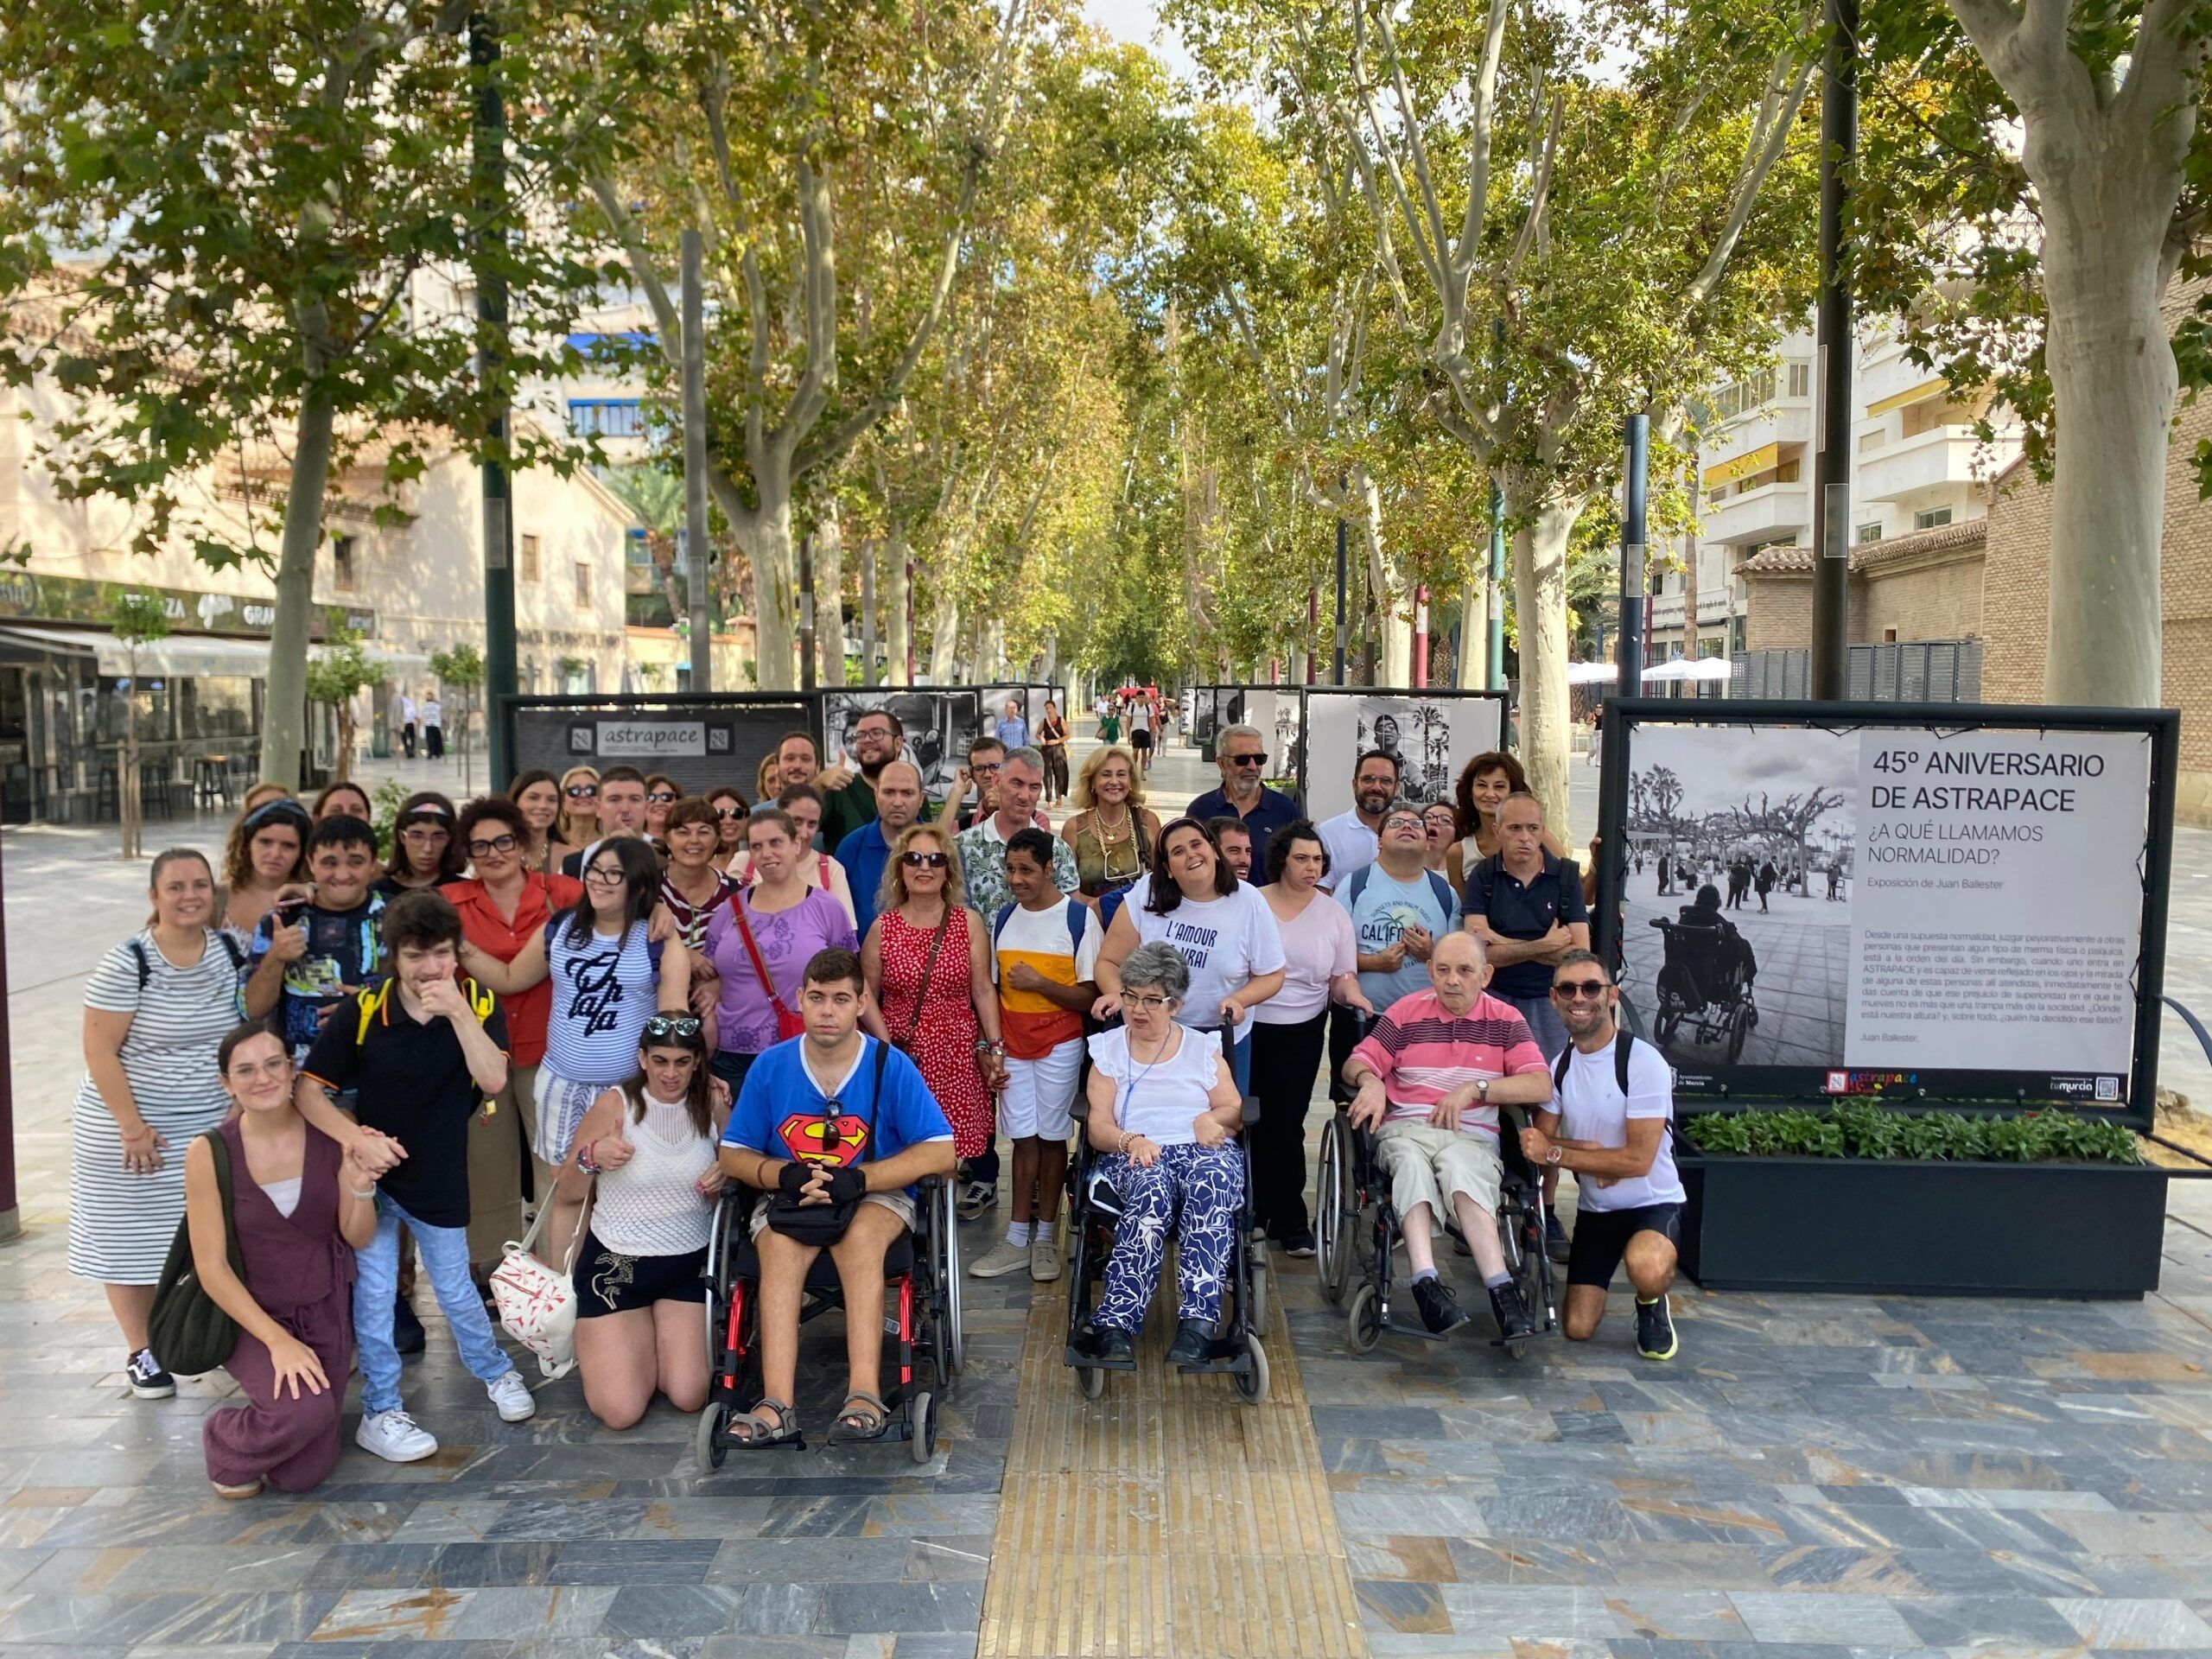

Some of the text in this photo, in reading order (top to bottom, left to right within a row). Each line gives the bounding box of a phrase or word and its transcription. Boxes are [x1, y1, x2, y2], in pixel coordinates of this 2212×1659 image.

[605, 727, 698, 748] astrapace
[1925, 752, 2104, 777] ANIVERSARIO
[1872, 786, 2075, 811] DE ASTRAPACE
[1869, 819, 2044, 842] ¿A QUÉ LLAMAMOS
[1868, 847, 1999, 864] NORMALIDAD?
[1868, 877, 2002, 889] Exposición de Juan Ballester
[1166, 920, 1218, 947] L'AMOUR
[1865, 931, 1891, 939] Desde
[1910, 932, 1948, 942] supuesta
[1864, 943, 1901, 952] personas
[1923, 944, 1965, 952] presentan
[1906, 954, 1930, 963] orden
[1863, 964, 1915, 974] ASTRAPACE
[1935, 968, 1960, 976] capaz
[1944, 979, 1982, 988] personas
[2094, 994, 2109, 1002] que
[1940, 1001, 1955, 1010] que
[1859, 1033, 1880, 1042] Juan
[1849, 1071, 1916, 1087] astrapace
